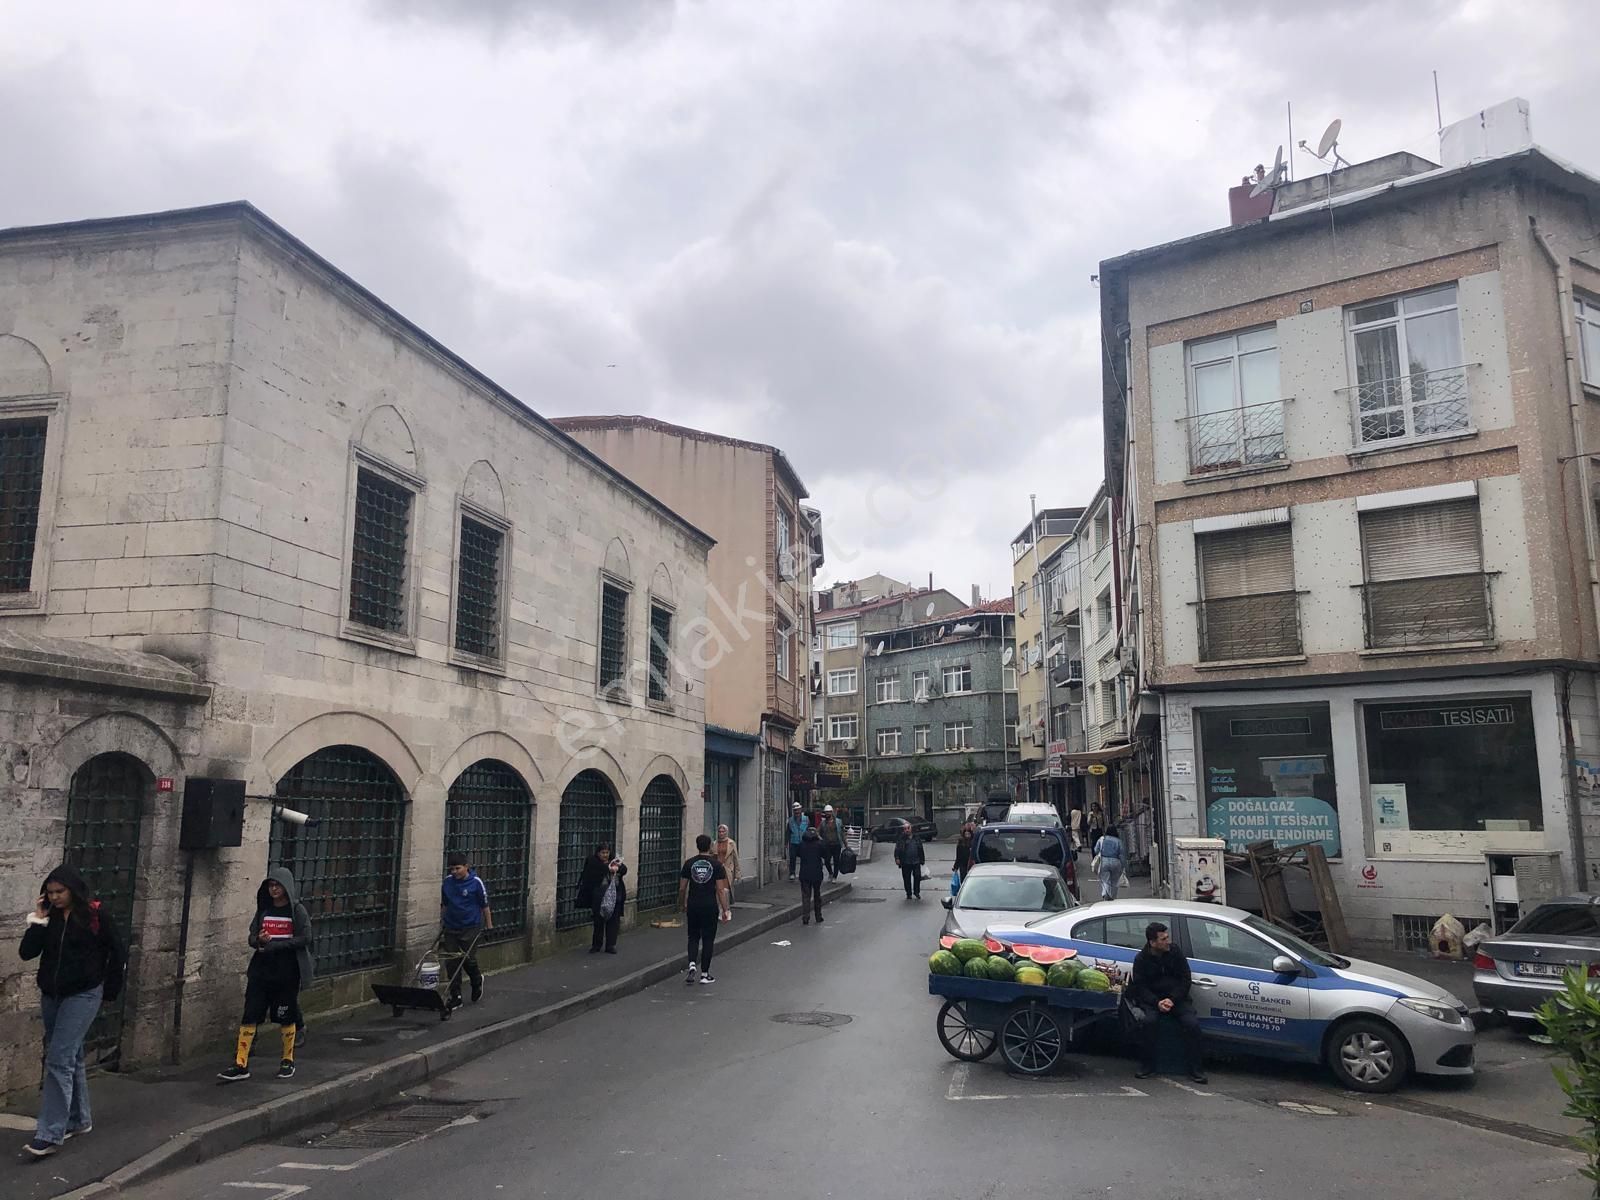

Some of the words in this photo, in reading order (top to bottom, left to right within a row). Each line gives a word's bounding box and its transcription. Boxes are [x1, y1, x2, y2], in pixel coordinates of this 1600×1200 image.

[1228, 799, 1296, 812] DOĞALGAZ
[1229, 814, 1269, 826] KOMBİ
[1272, 814, 1329, 826] TESİSATI
[1230, 828, 1334, 841] PROJELENDİRME
[1519, 963, 1530, 973] 34
[1218, 991, 1259, 1001] COLDWELL
[1260, 996, 1292, 1006] BANKER
[1227, 1019, 1245, 1027] 0505
[1246, 1021, 1260, 1029] 600
